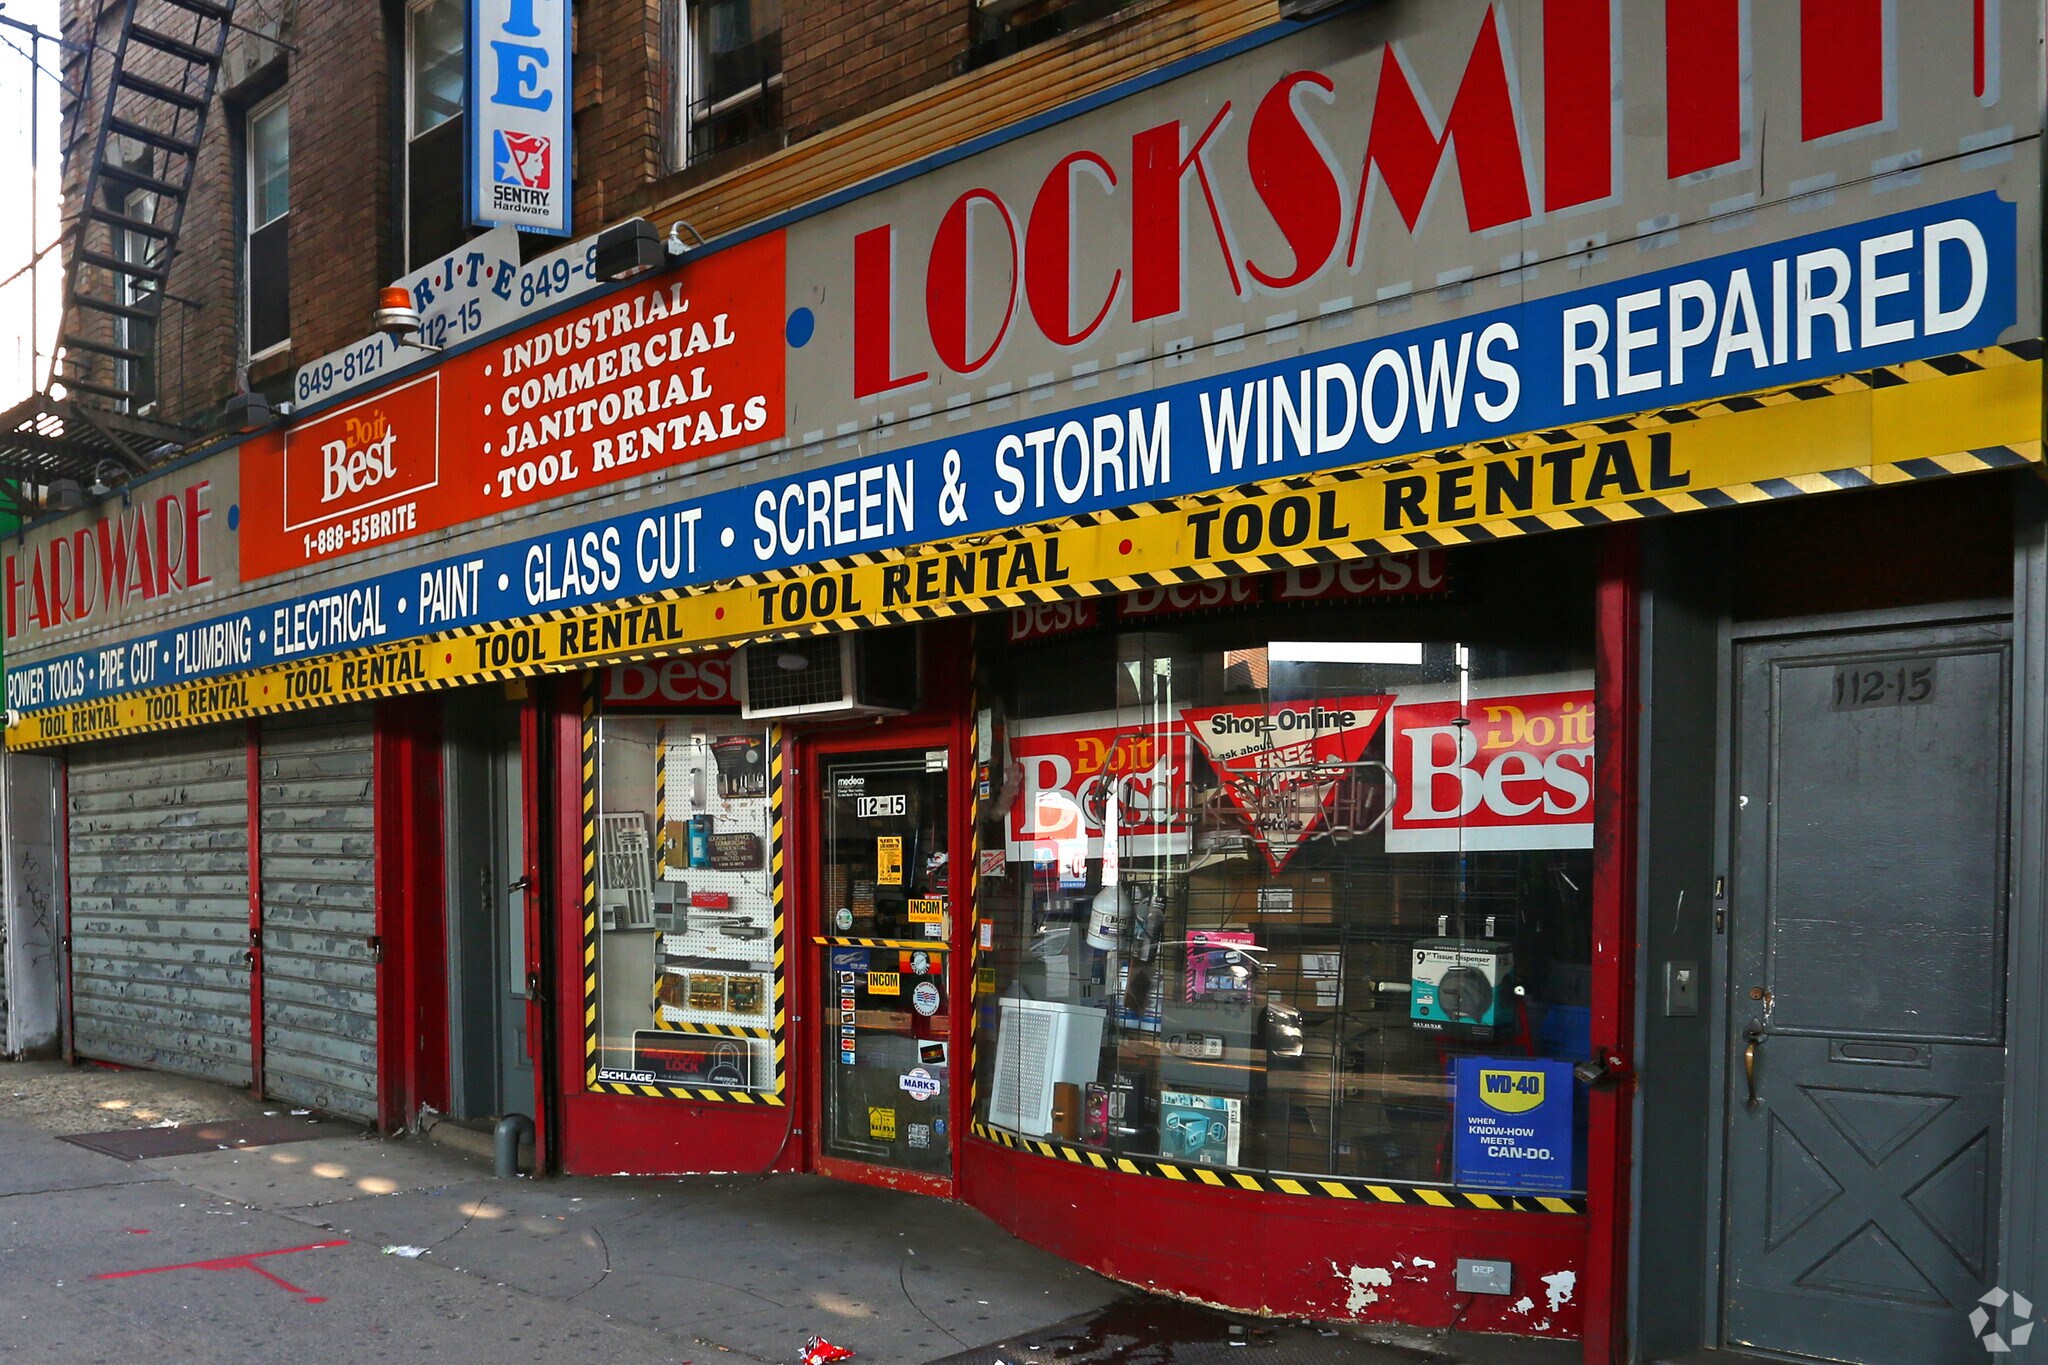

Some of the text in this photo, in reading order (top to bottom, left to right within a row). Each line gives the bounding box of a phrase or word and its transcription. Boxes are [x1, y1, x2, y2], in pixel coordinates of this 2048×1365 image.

[493, 184, 550, 207] SENTRY
[493, 200, 550, 216] Hardware
[418, 297, 483, 352] 112-15
[502, 282, 690, 378] INDUSTRIAL
[298, 339, 384, 401] 849-8121
[500, 313, 736, 416] COMMERCIAL
[500, 366, 713, 458] JANITORIAL
[7, 217, 1990, 710] POWER TOOLS PIPE CUT PLUMBING ELECTRICAL PAINT GLASS CUT SCREEN & STORM WINDOWS REPAIRED
[320, 424, 398, 503] Best
[497, 395, 768, 498] TOOL RENTALS
[1186, 431, 1692, 561] TOOL RENTAL
[303, 501, 417, 559] 1-888-55BRITE
[5, 479, 214, 639] HARDWARE
[757, 536, 1070, 627] TOOL RENTAL
[474, 603, 685, 670] TOOL RENTAL
[284, 649, 427, 701] TOOL RENTAL
[1833, 665, 1932, 706] 112-15
[145, 681, 250, 722] TOOL RENTAL
[39, 703, 120, 740] TOOL RENTAL
[1211, 707, 1357, 737] Shop Online
[1482, 705, 1556, 750] Do
[1219, 741, 1273, 761] ask about
[1254, 743, 1314, 775] FREE
[837, 775, 865, 786] medeco
[1400, 725, 1595, 821] Bes
[1020, 753, 1179, 834] Best
[910, 900, 940, 914] INCOM
[1432, 952, 1454, 961] Tissue
[1455, 954, 1491, 964] Dispenser
[869, 973, 898, 987] INCOM
[640, 1047, 705, 1063] AMERICAN
[665, 1060, 700, 1073] LOCK
[599, 1070, 653, 1082] SCHLAGE
[904, 1079, 935, 1091] MARKS
[1485, 1074, 1540, 1095] WD-40
[1468, 1117, 1496, 1125] WHEN
[1468, 1126, 1534, 1137] KNOW-HOW
[1480, 1136, 1515, 1146] MEETS
[1487, 1146, 1554, 1161] CAN-DO.
